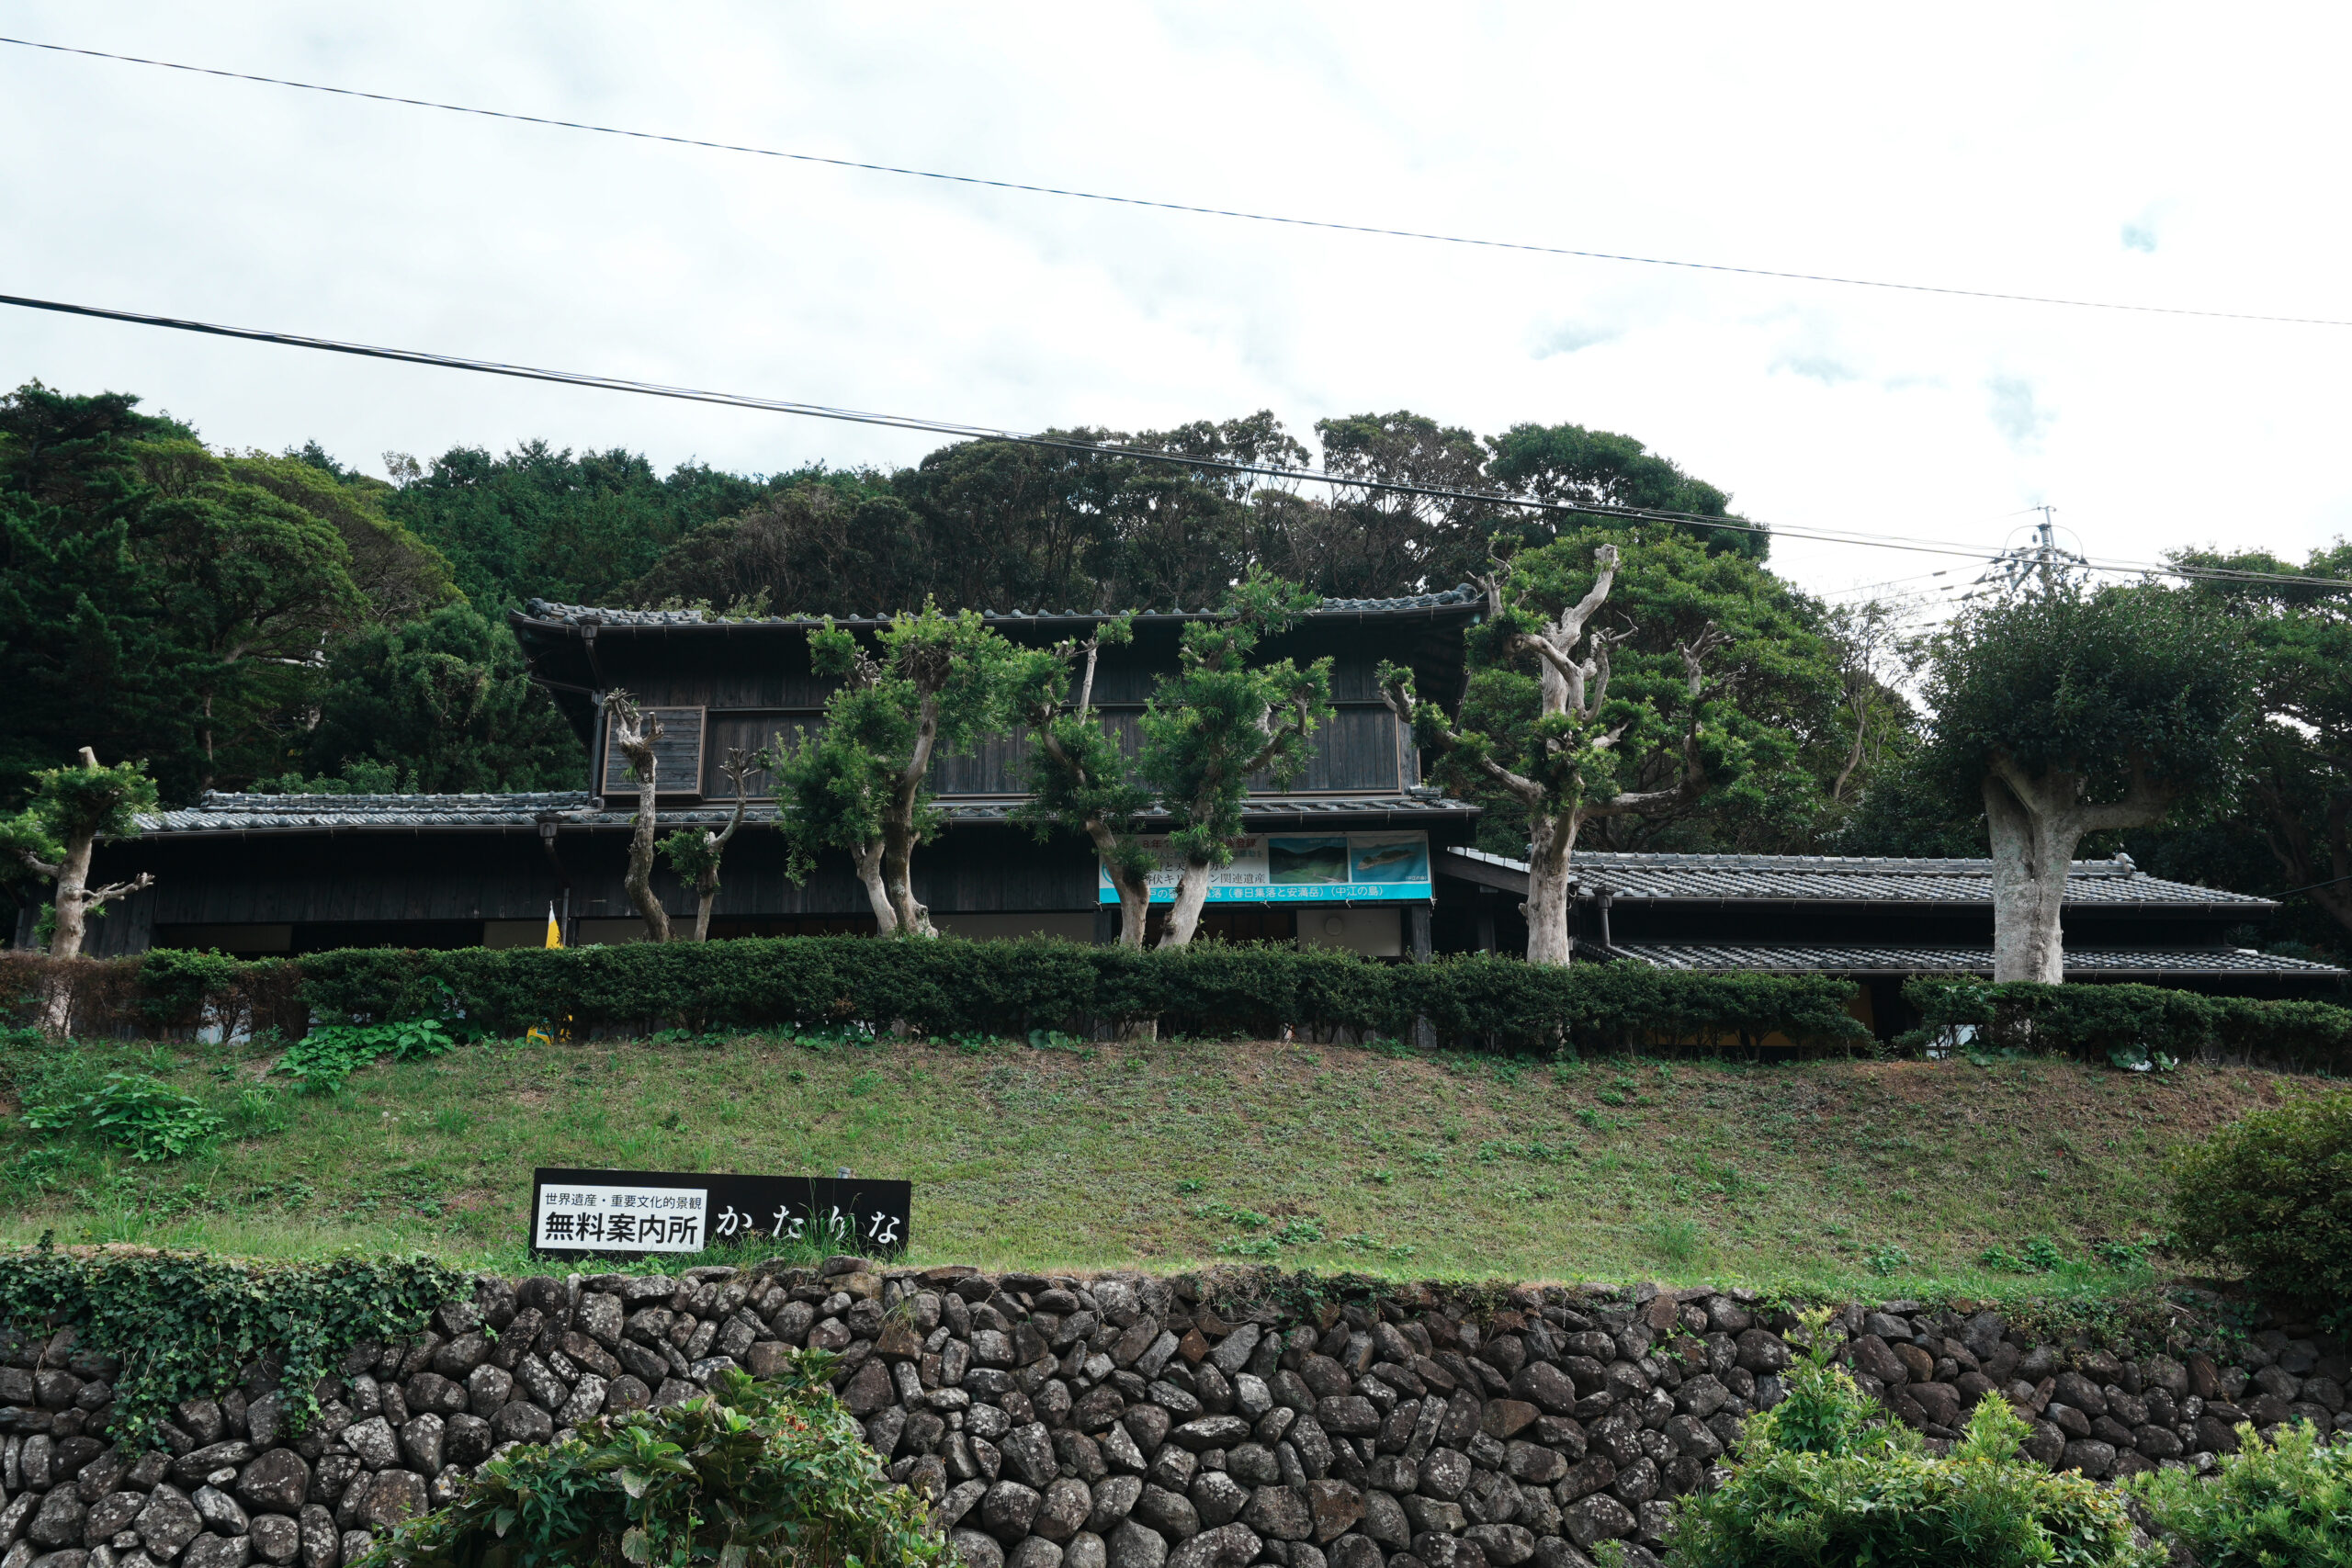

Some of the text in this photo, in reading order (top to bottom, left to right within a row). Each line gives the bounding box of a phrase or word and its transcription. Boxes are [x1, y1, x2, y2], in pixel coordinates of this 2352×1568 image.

[545, 1192, 702, 1211] 世界遺産・重要文化的景観
[544, 1211, 698, 1246] 無料案内所
